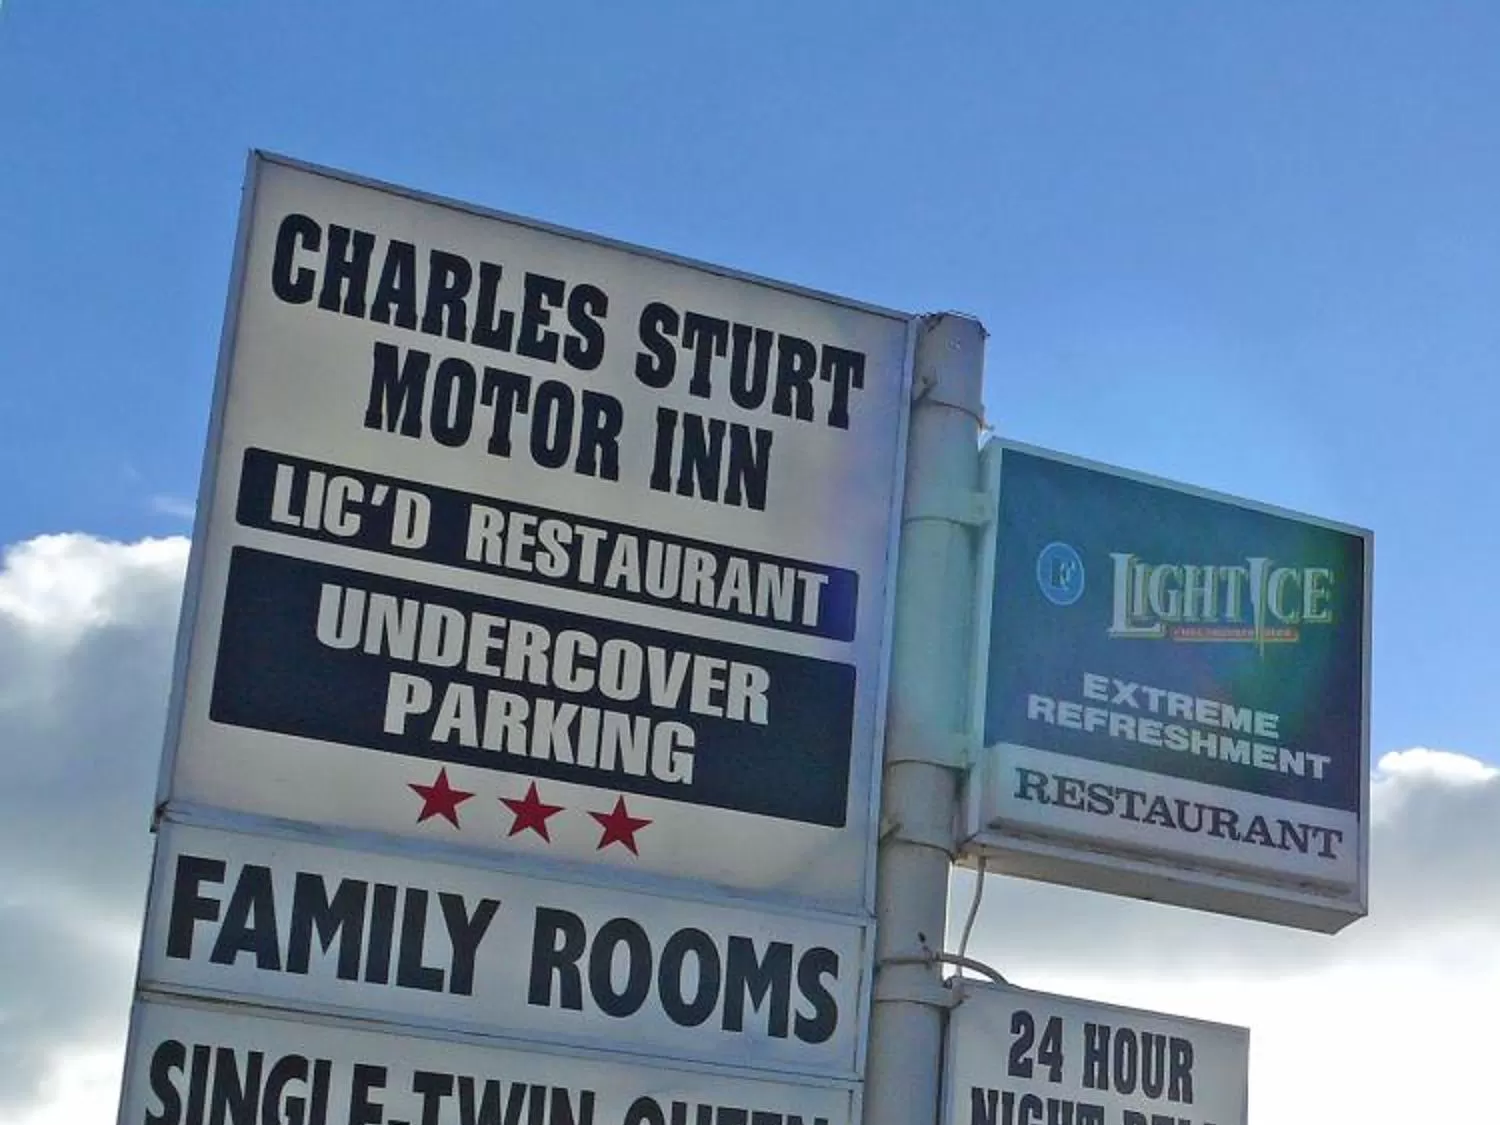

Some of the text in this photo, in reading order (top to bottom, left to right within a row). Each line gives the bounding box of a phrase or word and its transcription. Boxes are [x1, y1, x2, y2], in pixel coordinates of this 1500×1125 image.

[271, 213, 865, 430] CHARLES STURT
[364, 342, 774, 512] MOTOR INN
[271, 463, 828, 626] LIC'D RESTAURANT
[316, 583, 769, 725] UNDERCOVER
[1083, 672, 1279, 740] EXTREME
[383, 672, 695, 785] PARKING
[1027, 694, 1331, 780] REFRESHMENT
[1014, 767, 1343, 860] RESTAURANT
[165, 854, 839, 1044] FAMILY ROOMS
[1008, 1010, 1193, 1103] 24 HOUR
